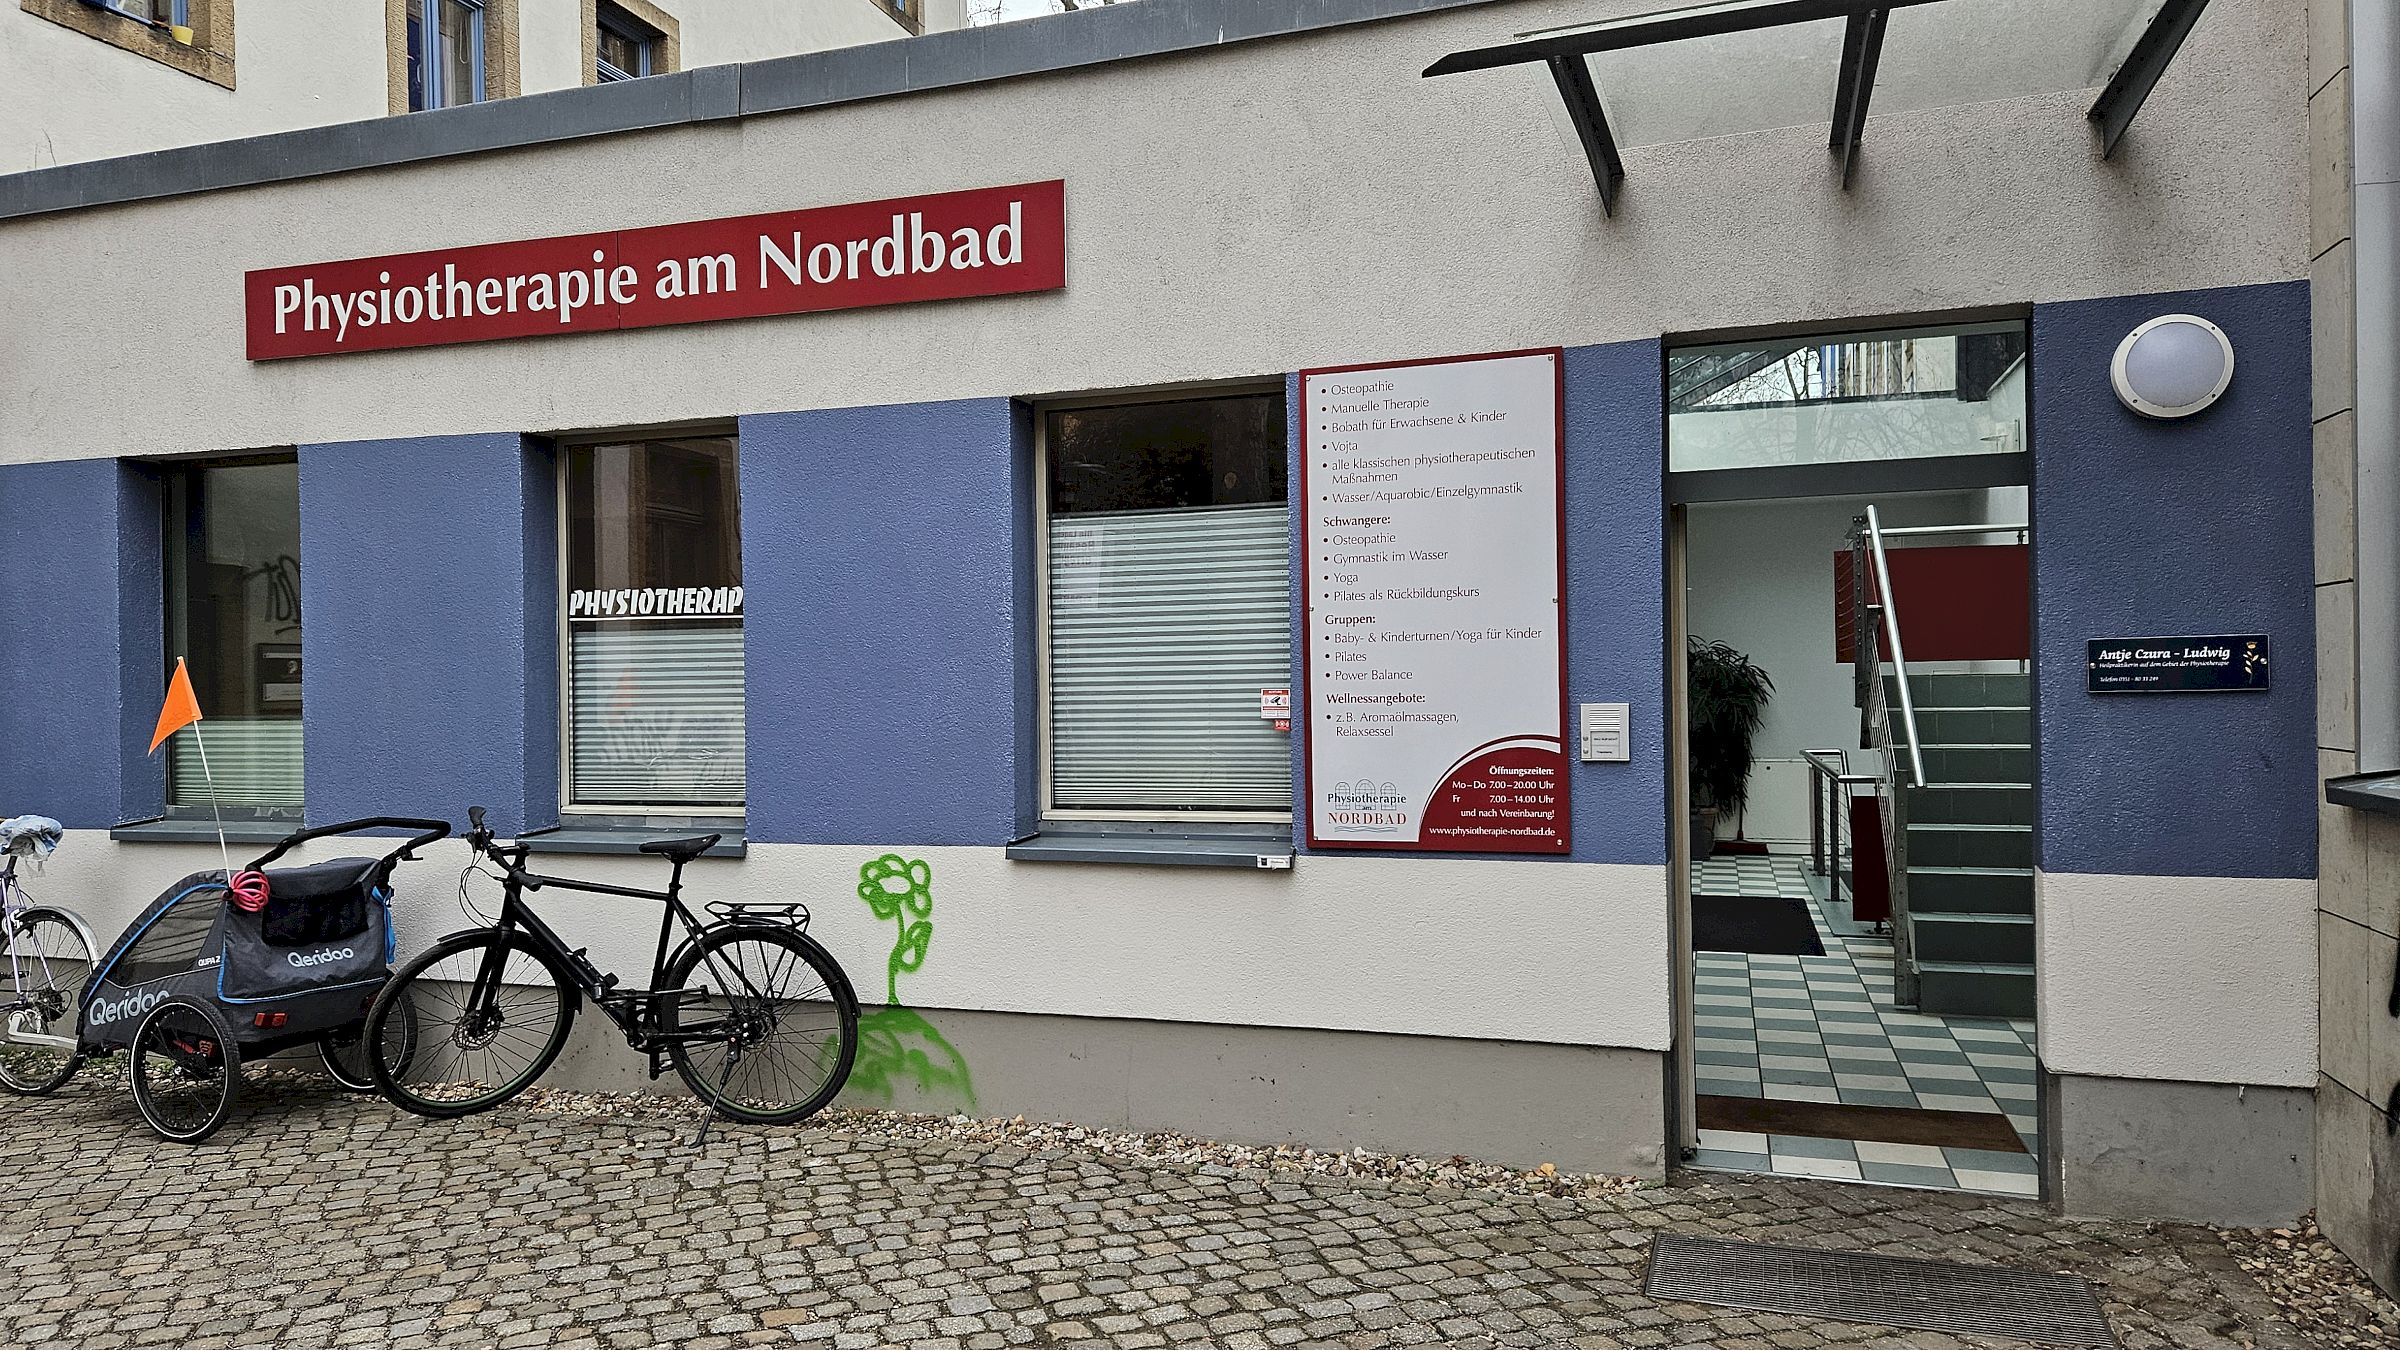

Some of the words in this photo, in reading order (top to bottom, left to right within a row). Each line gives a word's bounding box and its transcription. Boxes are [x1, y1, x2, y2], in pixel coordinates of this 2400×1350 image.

[274, 249, 638, 342] Physiotherapie
[655, 252, 737, 300] am
[759, 201, 1022, 289] Nordbad
[1331, 381, 1394, 396] Osteopathie
[1331, 400, 1380, 414] Manuelle
[1383, 397, 1430, 411] Therapie
[1332, 420, 1369, 433] Bobath
[1372, 419, 1387, 430] für
[1390, 416, 1454, 429] Erwachsene
[1457, 413, 1467, 424] &
[1471, 410, 1507, 423] Kinder
[1331, 441, 1358, 454] Vojta
[1332, 459, 1350, 471] alle
[1353, 456, 1410, 469] klassischen
[1414, 448, 1535, 468] physiotherapeutischen
[1332, 472, 1398, 484] Maßnahmen
[1332, 482, 1523, 503] Wasser/Aquarobic/Einzelgymnastik
[1323, 516, 1391, 528] Schwangere:
[1332, 533, 1396, 547] Osteopathie
[1333, 551, 1388, 567] Gymnastik
[1392, 551, 1405, 561] im
[1409, 550, 1448, 561] Wasser
[1334, 573, 1358, 585] Yoga
[1334, 590, 1365, 601] Pilates
[1369, 589, 1383, 600] als
[1387, 586, 1480, 601] Rückbildungskurs
[569, 586, 744, 616] PHYSIOTHERAP
[1325, 615, 1376, 627] Gruppen:
[1334, 632, 1364, 646] Baby-
[1368, 632, 1377, 642] &
[1381, 629, 1482, 643] Kinderturnen/Yoga
[1486, 628, 1501, 639] für
[1505, 627, 1542, 639] Kinder
[1335, 651, 1367, 662] Pilates
[2098, 648, 2132, 662] Antje
[2135, 649, 2171, 659] Czura
[2183, 646, 2231, 660] Ludwig
[1335, 670, 1367, 680] Power
[1371, 669, 1413, 680] Balance
[1326, 692, 1426, 706] Wellnessangebote:
[1360, 711, 1459, 725] Aromaölmassagen,
[1336, 726, 1394, 737] Relaxsessel
[1489, 765, 1555, 777] Öffnungszeiten:
[1539, 781, 1555, 789] Uhr
[1327, 793, 1407, 806] Physiotherapie
[1452, 795, 1461, 803] Fr
[1539, 795, 1555, 803] Uhr
[1328, 812, 1407, 825] NORDBAD
[1461, 808, 1477, 817] und
[1478, 808, 1498, 817] nach
[1499, 809, 1555, 820] Vereinbarung!
[1429, 826, 1556, 837] www.physiotherapie-nordbad.de
[287, 947, 354, 968] Qeridoo
